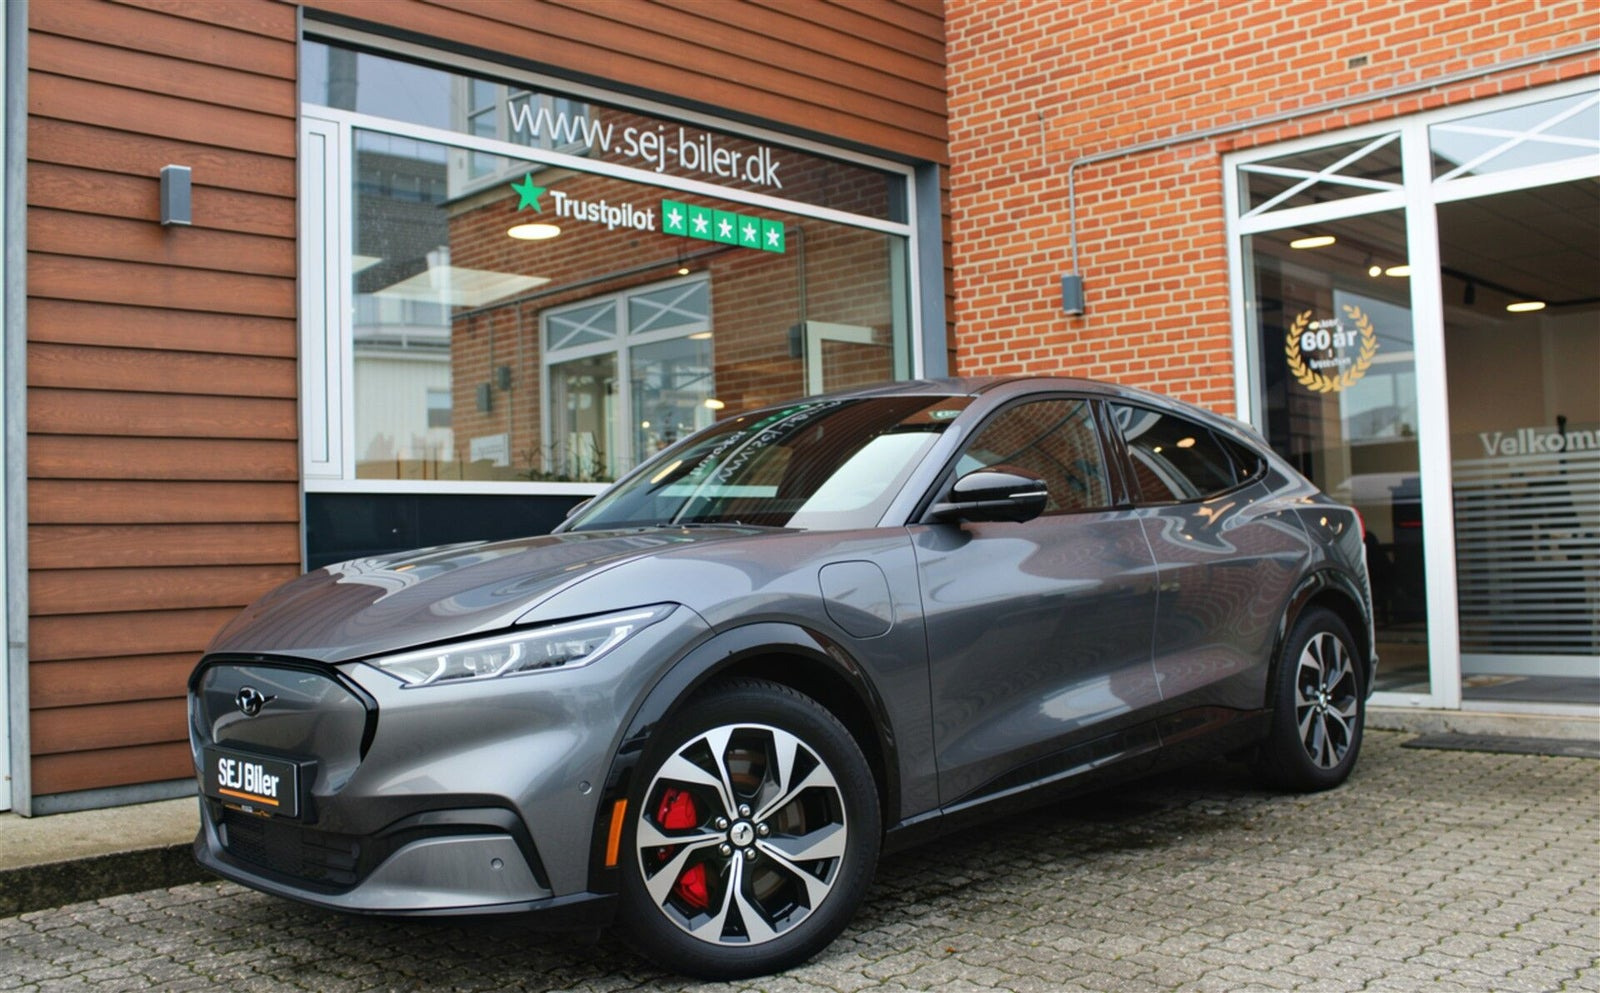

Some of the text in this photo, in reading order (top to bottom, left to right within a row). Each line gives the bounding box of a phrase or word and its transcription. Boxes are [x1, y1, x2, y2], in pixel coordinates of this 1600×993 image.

[508, 101, 783, 188] www.sej-biler.dk
[550, 190, 655, 231] Trustpilot
[1301, 329, 1331, 351] 60
[1478, 428, 1600, 456] Velkom
[218, 758, 279, 797] SEJ Biler
